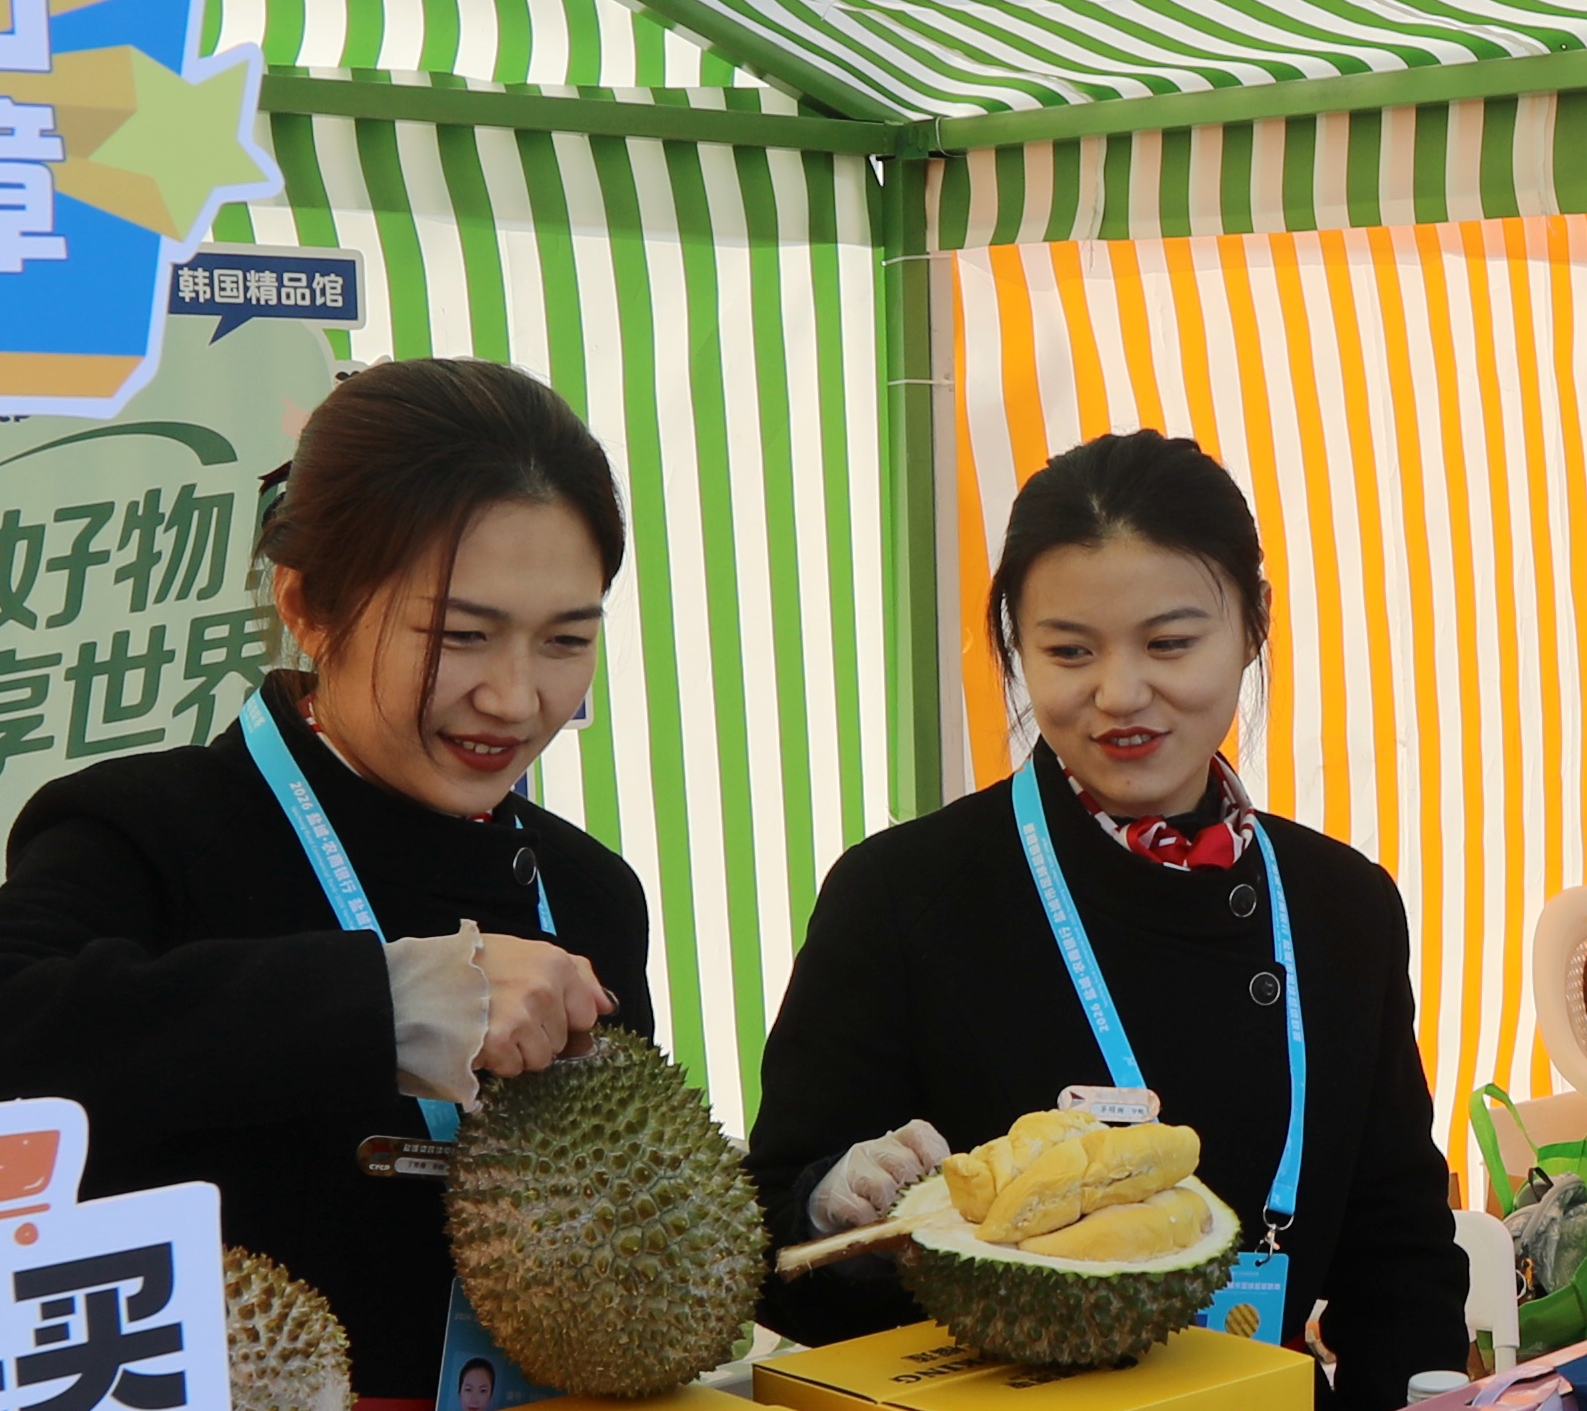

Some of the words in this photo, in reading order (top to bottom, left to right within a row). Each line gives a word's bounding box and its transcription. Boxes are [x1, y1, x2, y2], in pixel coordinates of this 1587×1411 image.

[176, 267, 345, 309] 韩国精品馆
